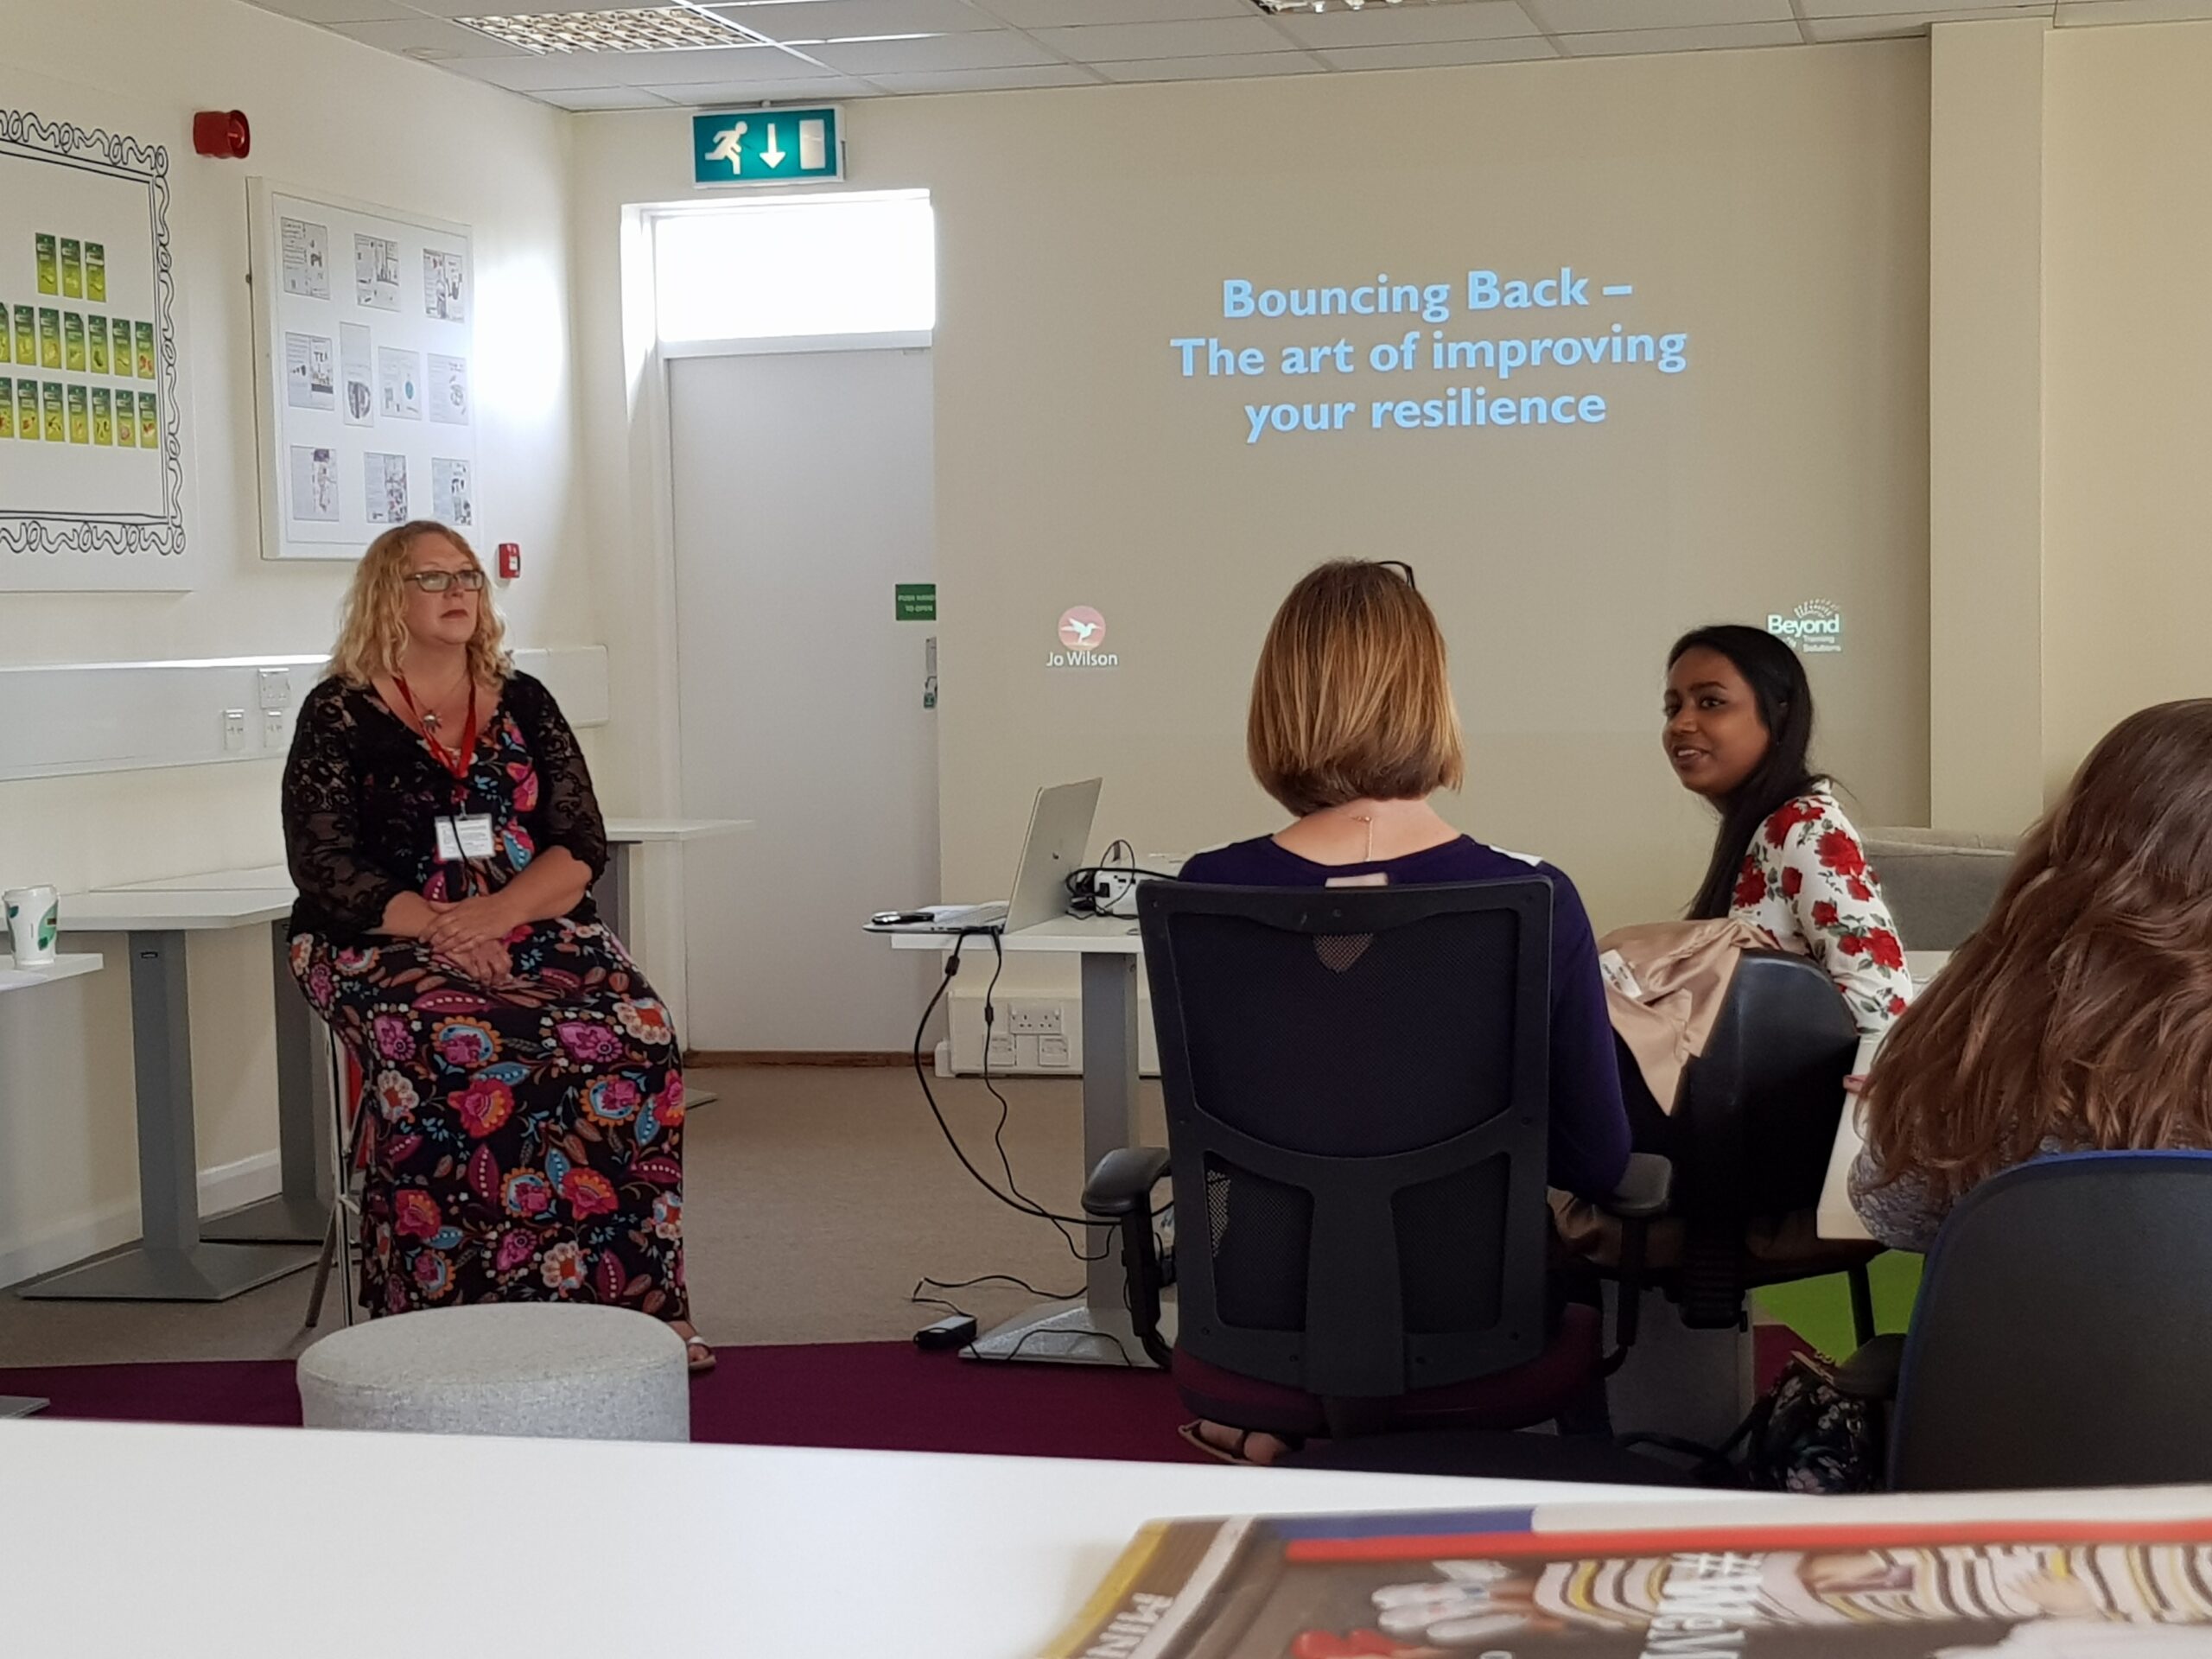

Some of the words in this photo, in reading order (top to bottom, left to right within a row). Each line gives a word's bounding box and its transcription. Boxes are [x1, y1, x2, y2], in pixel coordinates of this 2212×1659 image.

[1224, 274, 1451, 323] Bouncing
[1468, 267, 1589, 310] Back
[1170, 336, 1265, 377] The
[1281, 339, 1354, 374] art
[1370, 331, 1421, 372] of
[1433, 323, 1688, 379] improving
[1244, 401, 1356, 443] your
[1372, 386, 1606, 429] resilience
[1767, 613, 1840, 638] Beyond
[1046, 652, 1064, 667] Jo
[1066, 650, 1119, 666] Wilson
